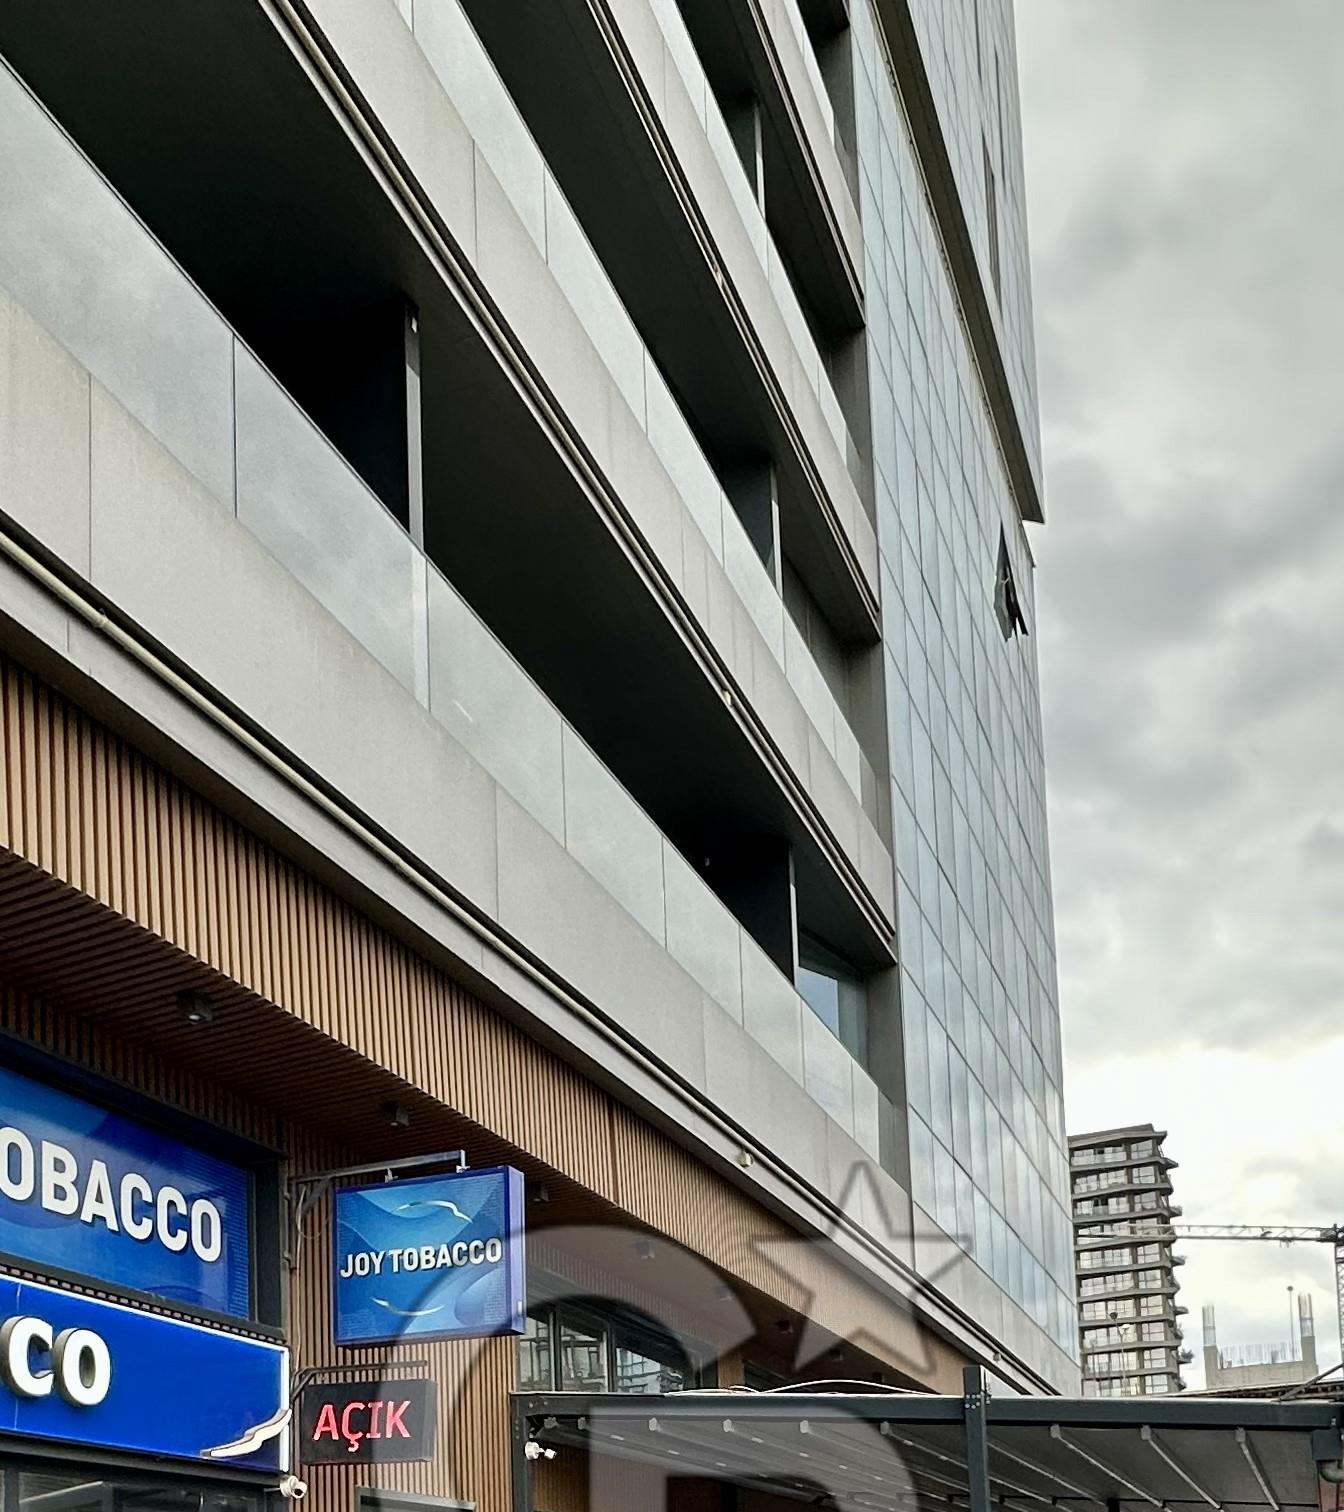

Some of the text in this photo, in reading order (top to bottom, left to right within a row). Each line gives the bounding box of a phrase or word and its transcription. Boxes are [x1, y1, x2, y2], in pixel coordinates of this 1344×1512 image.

[340, 1237, 503, 1278] JOY TOBACCO
[313, 1400, 412, 1452] AÇIK
